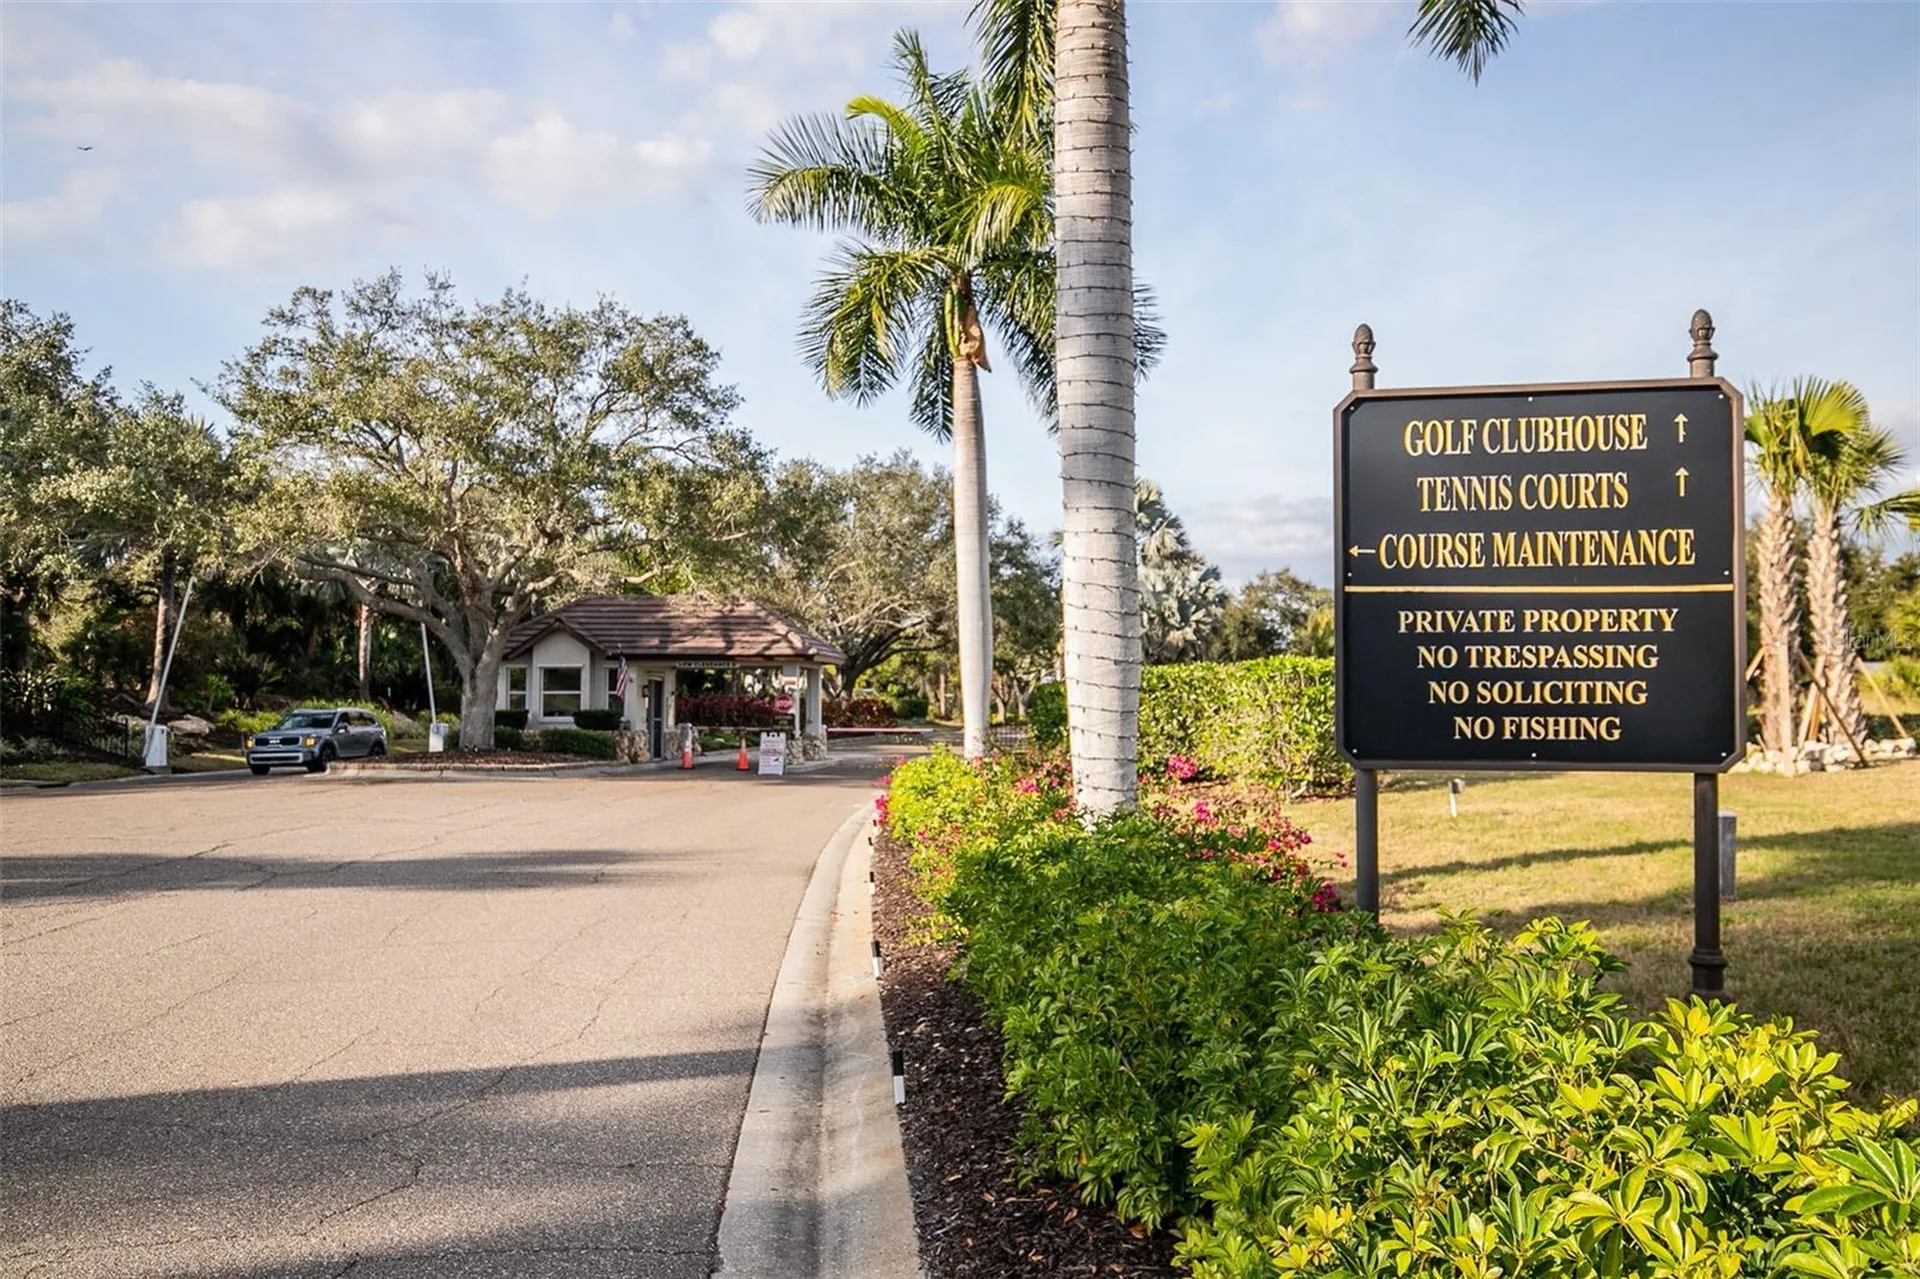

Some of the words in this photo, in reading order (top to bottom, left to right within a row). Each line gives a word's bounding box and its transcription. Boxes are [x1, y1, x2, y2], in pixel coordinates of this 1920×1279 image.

[1403, 418, 1477, 457] GOLF
[1482, 413, 1649, 455] CLUBHOUSE
[1416, 474, 1513, 513] TENNIS
[1519, 471, 1629, 511] COURTS
[1378, 531, 1486, 570] COURSE
[1492, 528, 1696, 568] MAINTENANCE
[1398, 609, 1516, 634] PRIVATE
[1522, 607, 1679, 633] PROPERTY
[1417, 645, 1458, 669] NO
[1465, 644, 1660, 669] TRESPASSING
[1428, 680, 1470, 705] NO
[1476, 680, 1649, 705] SOLICITING
[1453, 716, 1495, 740] NO
[1502, 716, 1622, 741] FISHING
